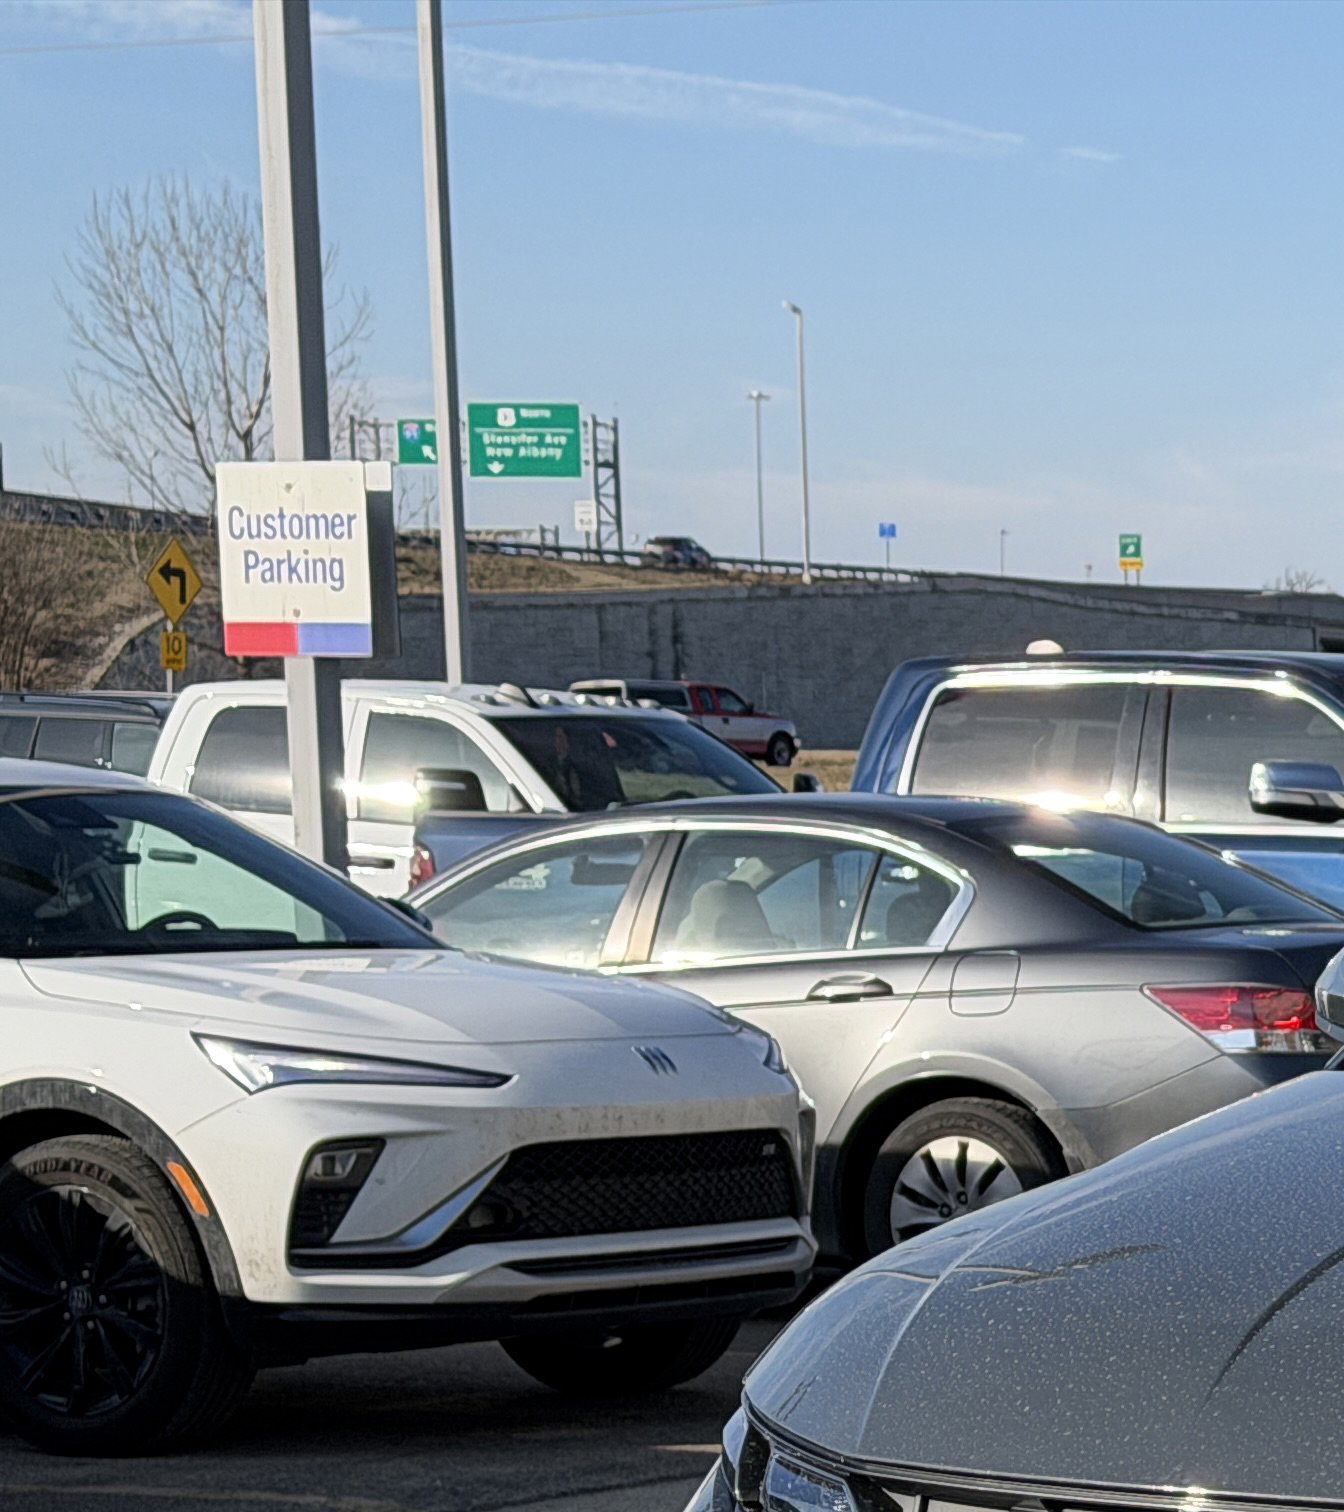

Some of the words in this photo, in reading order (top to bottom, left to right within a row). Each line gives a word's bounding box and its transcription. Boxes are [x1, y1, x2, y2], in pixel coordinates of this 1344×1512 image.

[485, 446, 514, 458] New
[228, 505, 357, 540] Customer
[243, 548, 345, 592] Parking
[165, 635, 183, 656] 10
